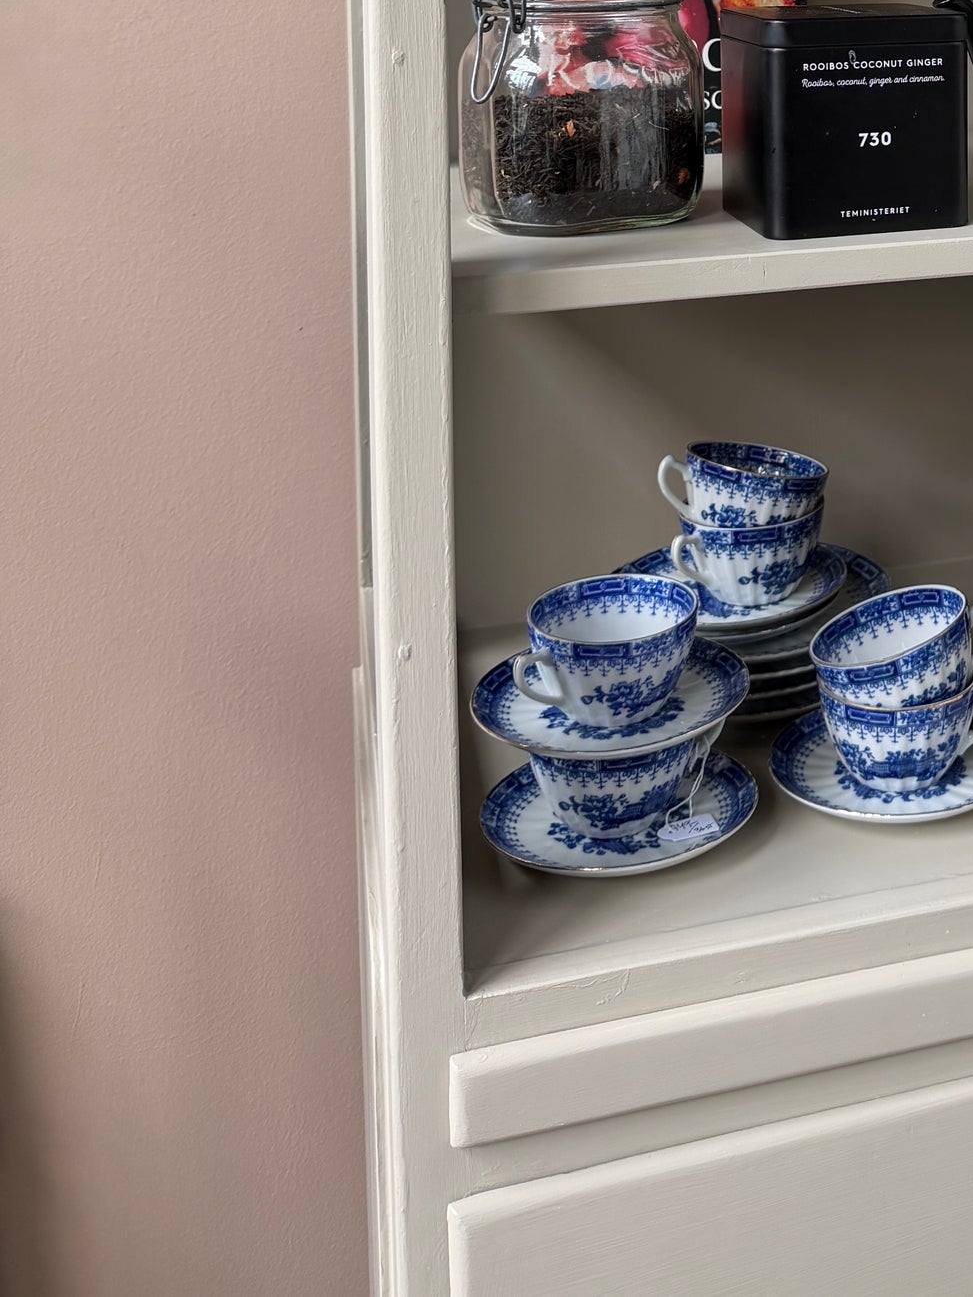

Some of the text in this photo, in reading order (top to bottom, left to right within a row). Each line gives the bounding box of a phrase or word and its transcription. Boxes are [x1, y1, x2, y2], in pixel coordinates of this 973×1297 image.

[803, 58, 943, 71] ROOIBOS COCONUT GINGER
[801, 74, 945, 88] Rooibos, coconut, ginger and cinnamon.
[858, 132, 892, 147] 730
[840, 206, 910, 218] TEMINISTERIET
